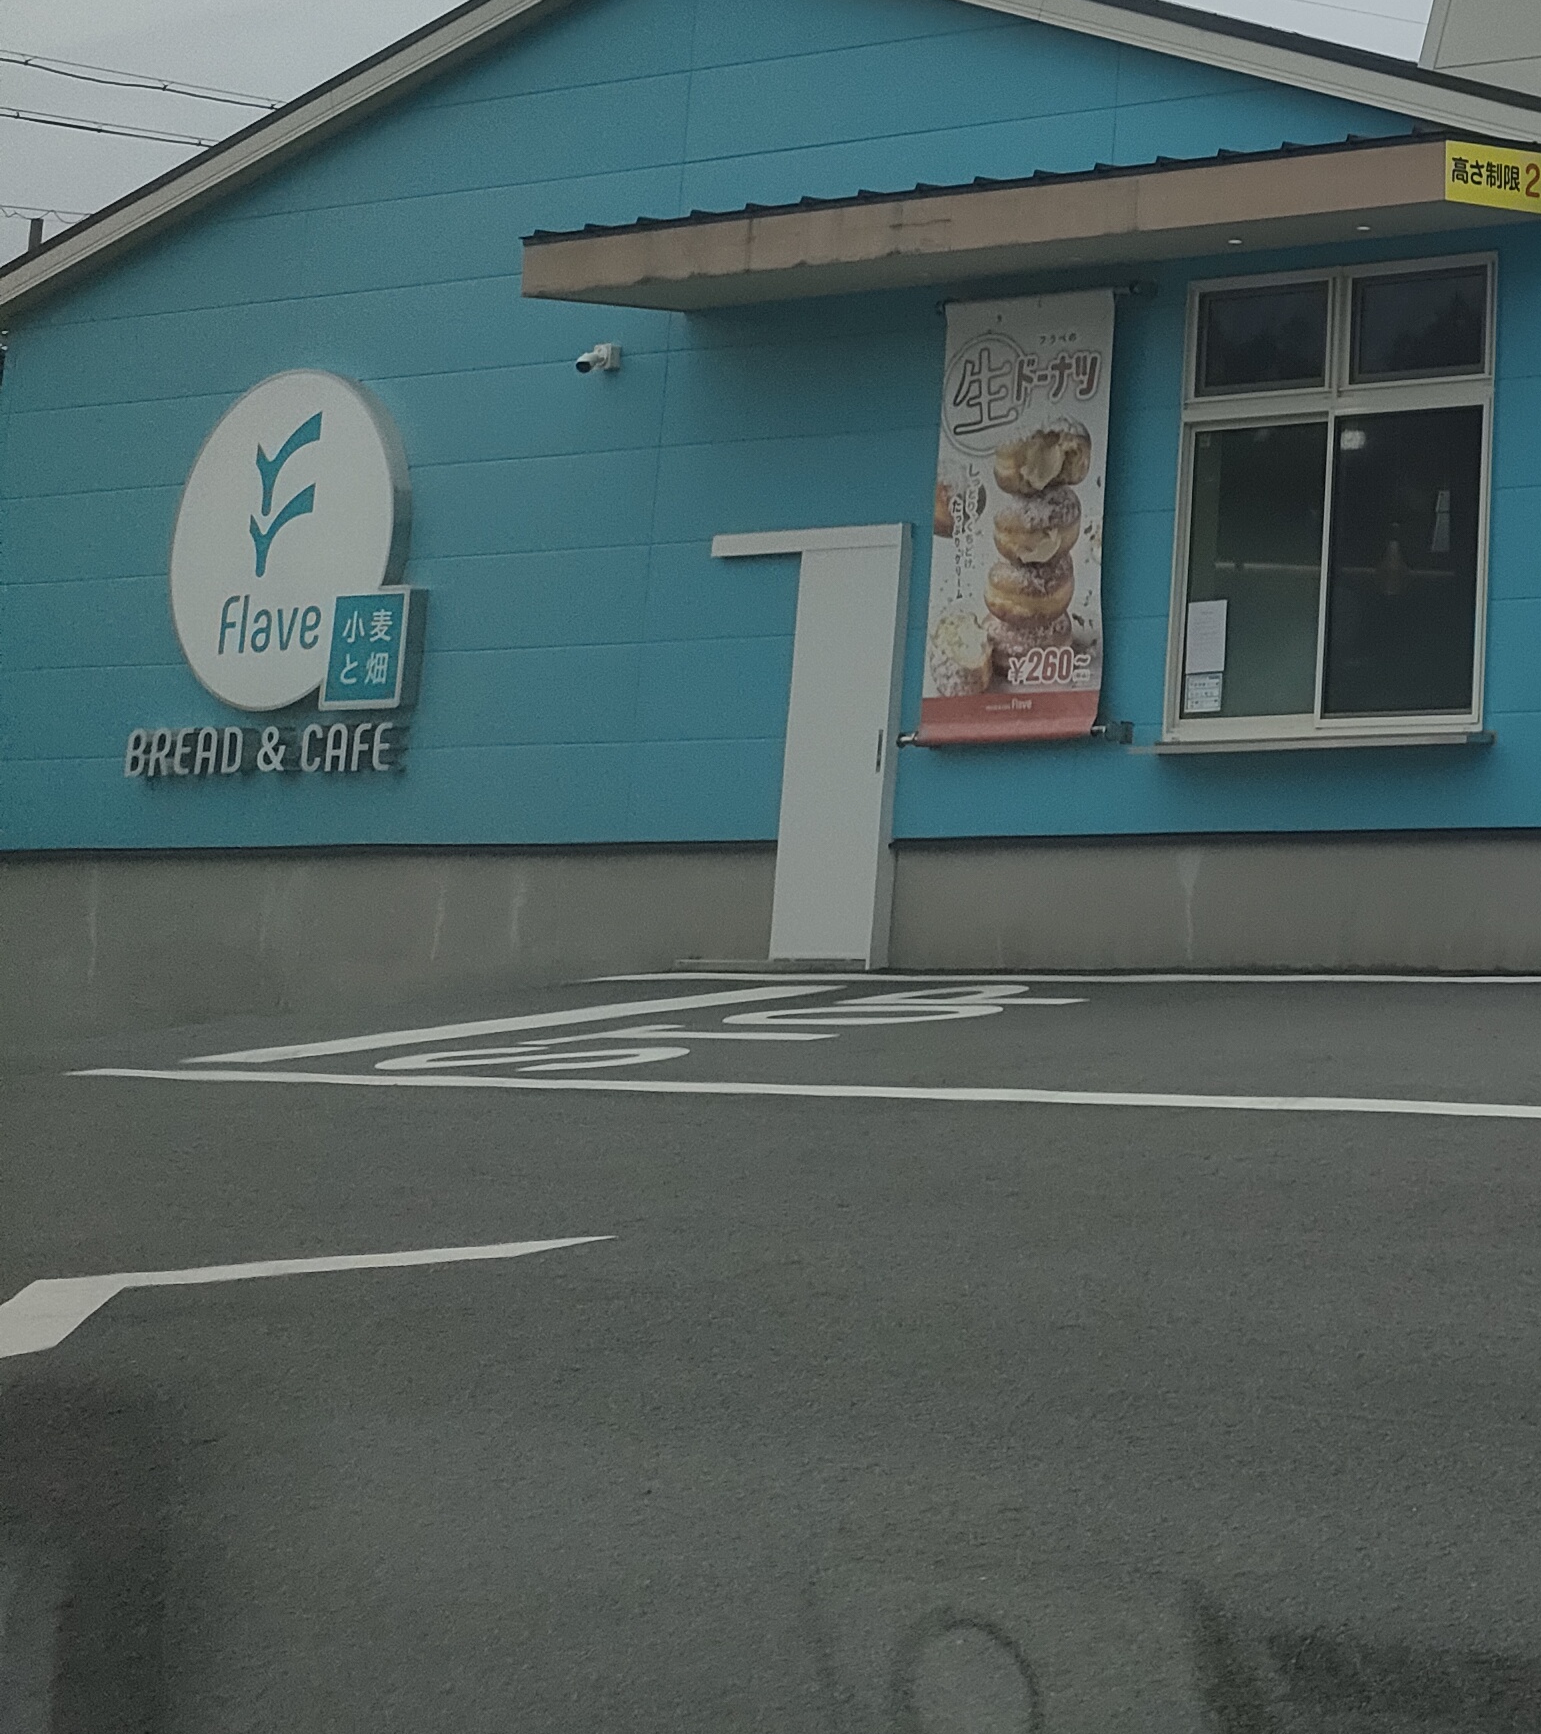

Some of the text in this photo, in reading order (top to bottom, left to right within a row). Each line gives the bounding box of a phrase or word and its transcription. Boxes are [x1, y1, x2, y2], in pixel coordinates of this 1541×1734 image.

[1451, 156, 1520, 192] 高さ制限
[218, 595, 321, 654] Flave
[342, 609, 393, 644] 小麦
[338, 652, 388, 685] と畑
[124, 722, 394, 777] BREAD & CAFE
